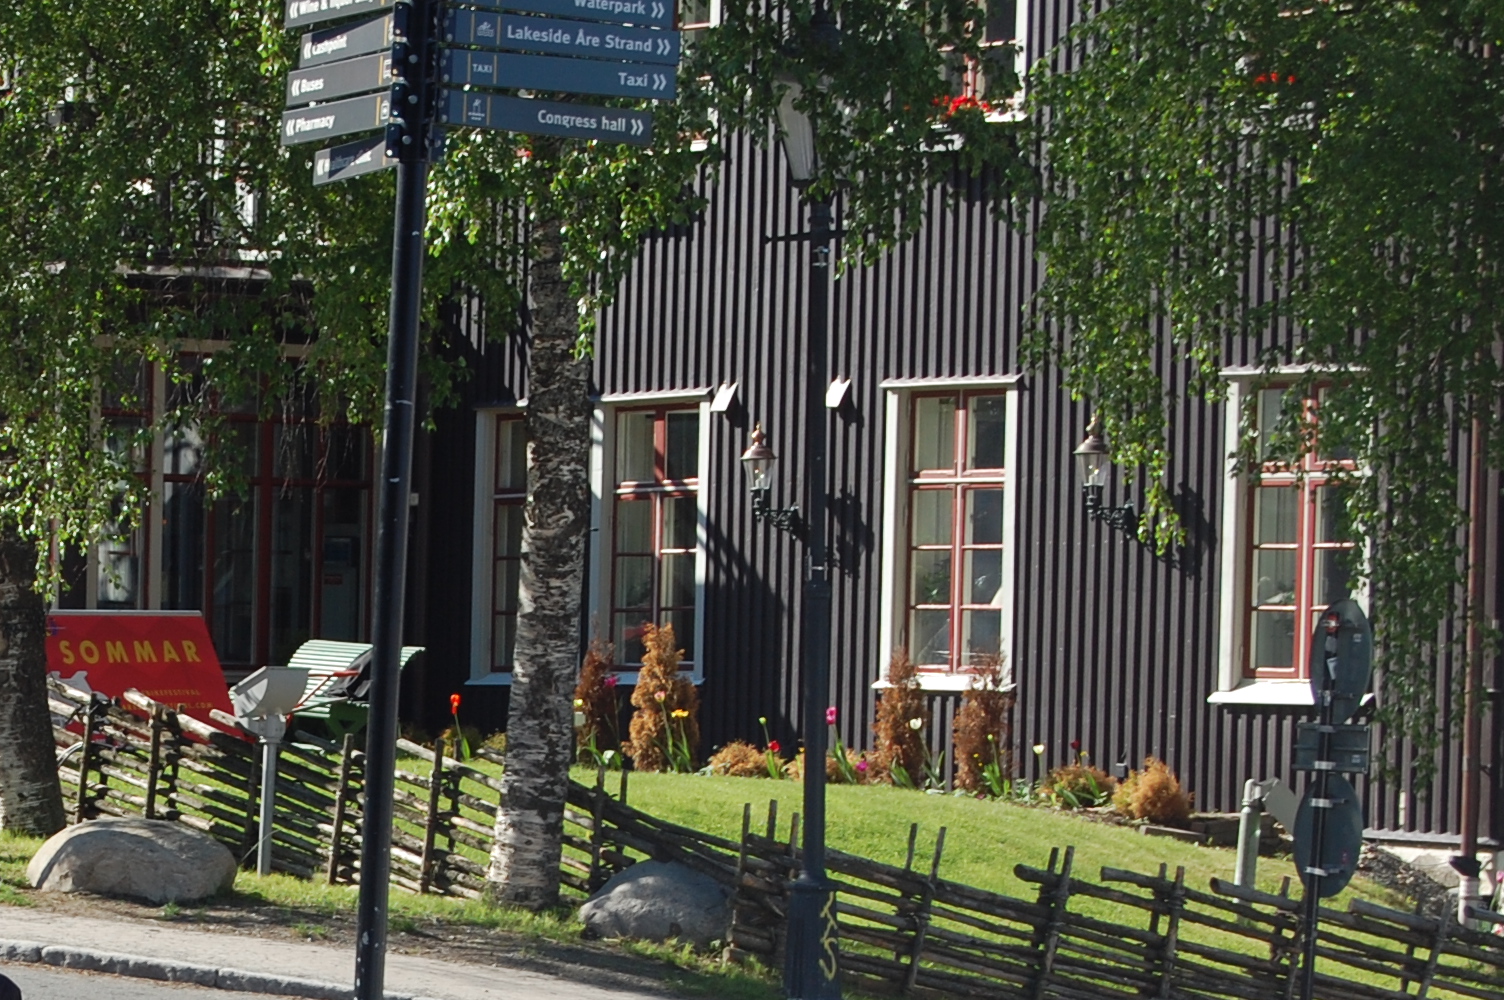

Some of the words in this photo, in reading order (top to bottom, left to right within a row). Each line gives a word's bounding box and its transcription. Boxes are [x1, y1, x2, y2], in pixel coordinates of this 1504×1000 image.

[574, 0, 645, 15] Waterpark
[507, 25, 571, 45] Lakeside
[575, 29, 601, 48] Åre
[605, 35, 653, 52] Strand
[472, 63, 493, 74] TAXI
[300, 78, 324, 93] Buses
[618, 72, 649, 88] Taxi
[295, 115, 335, 133] Pharmacy
[538, 109, 597, 129] Congress
[601, 118, 626, 132] hall
[59, 640, 202, 664] SOMMAR
